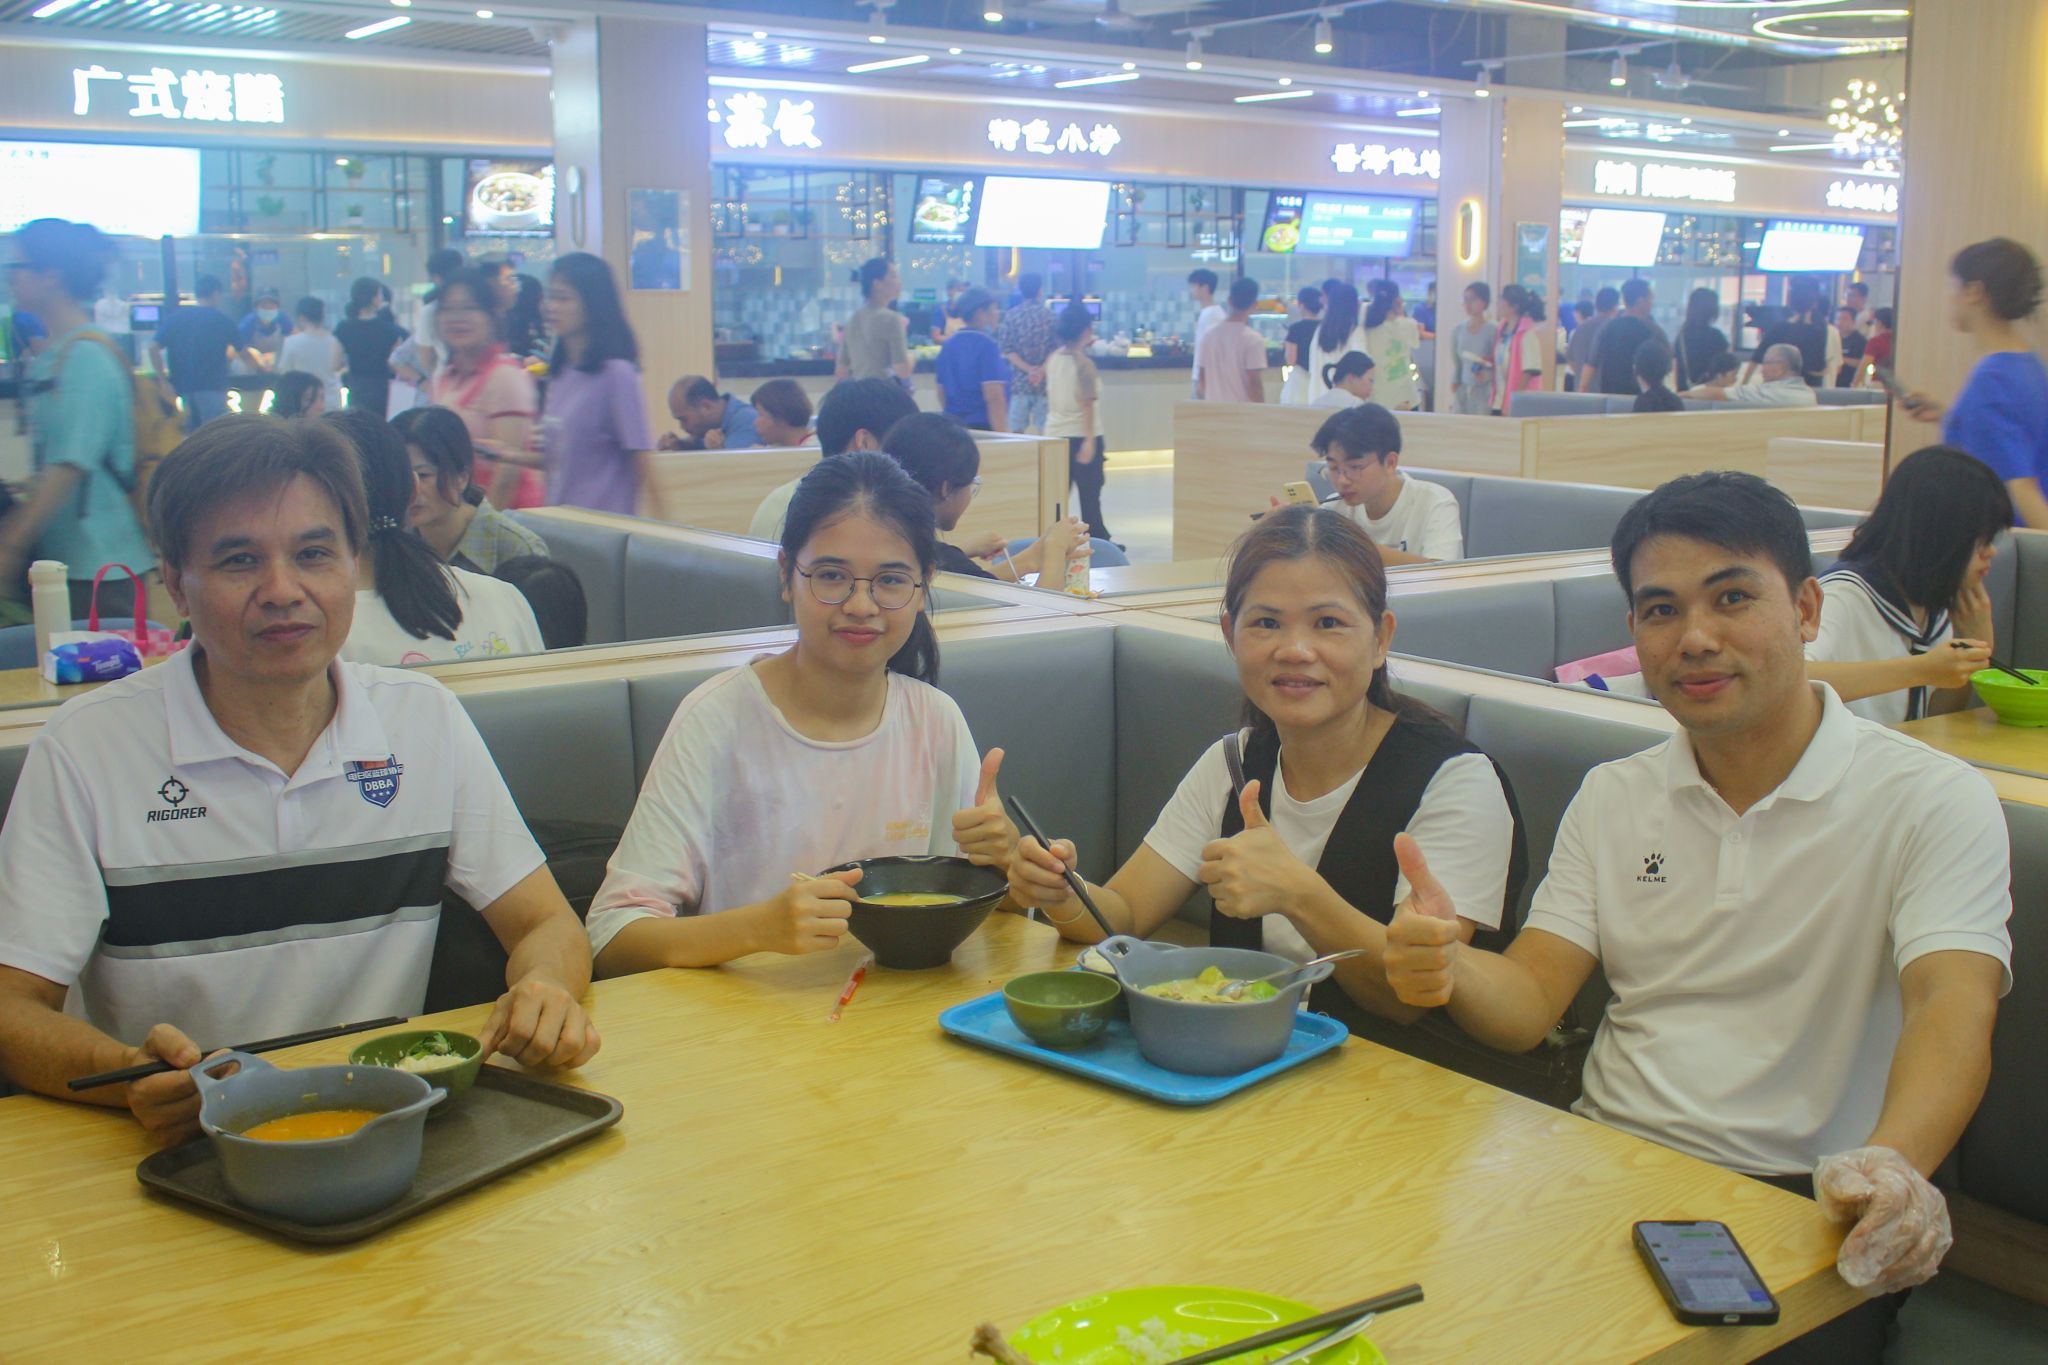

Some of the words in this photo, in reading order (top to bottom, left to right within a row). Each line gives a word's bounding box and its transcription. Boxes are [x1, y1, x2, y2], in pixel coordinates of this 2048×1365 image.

[707, 91, 823, 149] 蒸饭
[365, 779, 394, 791] DBBA
[147, 807, 207, 823] RIGORER
[1636, 875, 1667, 883] KELME
